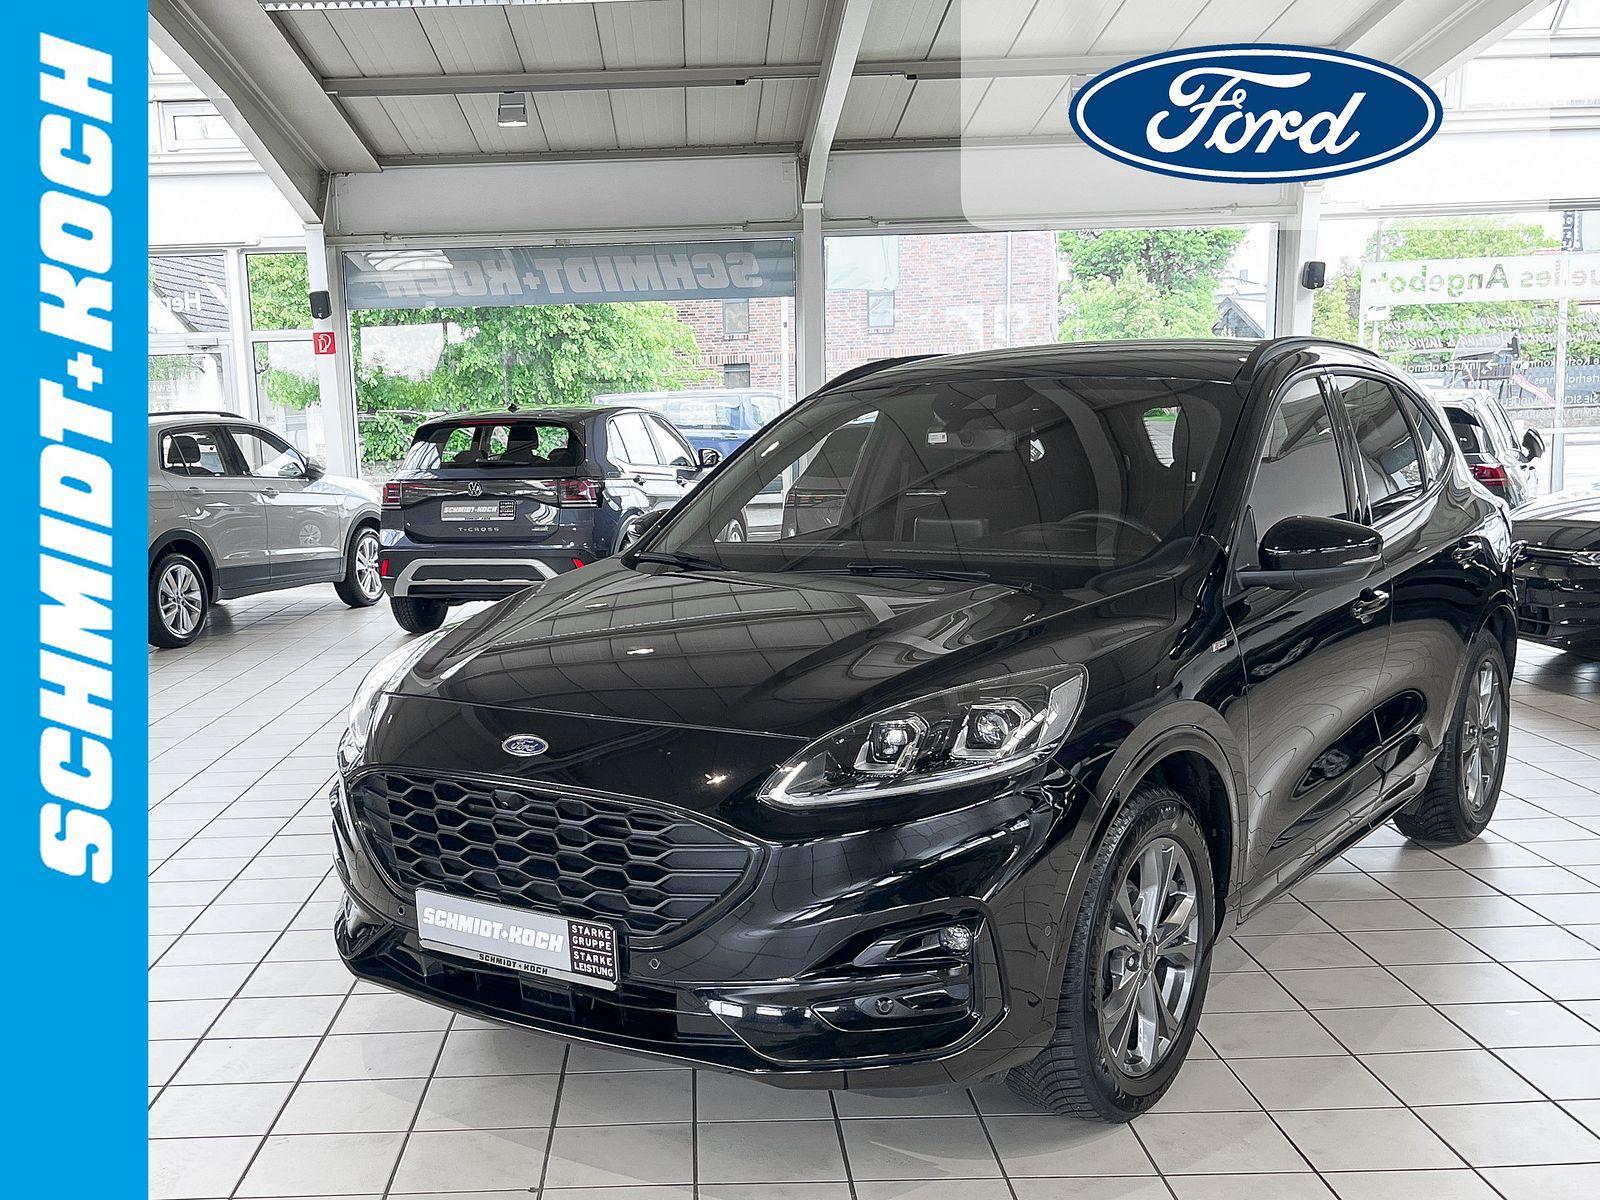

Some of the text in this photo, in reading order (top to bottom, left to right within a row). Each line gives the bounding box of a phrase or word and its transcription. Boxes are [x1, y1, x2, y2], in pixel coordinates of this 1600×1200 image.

[572, 924, 611, 939] STARKE
[572, 936, 612, 951] GRUPPE
[573, 951, 613, 966] STARKE
[573, 962, 614, 977] LEISTUNG
